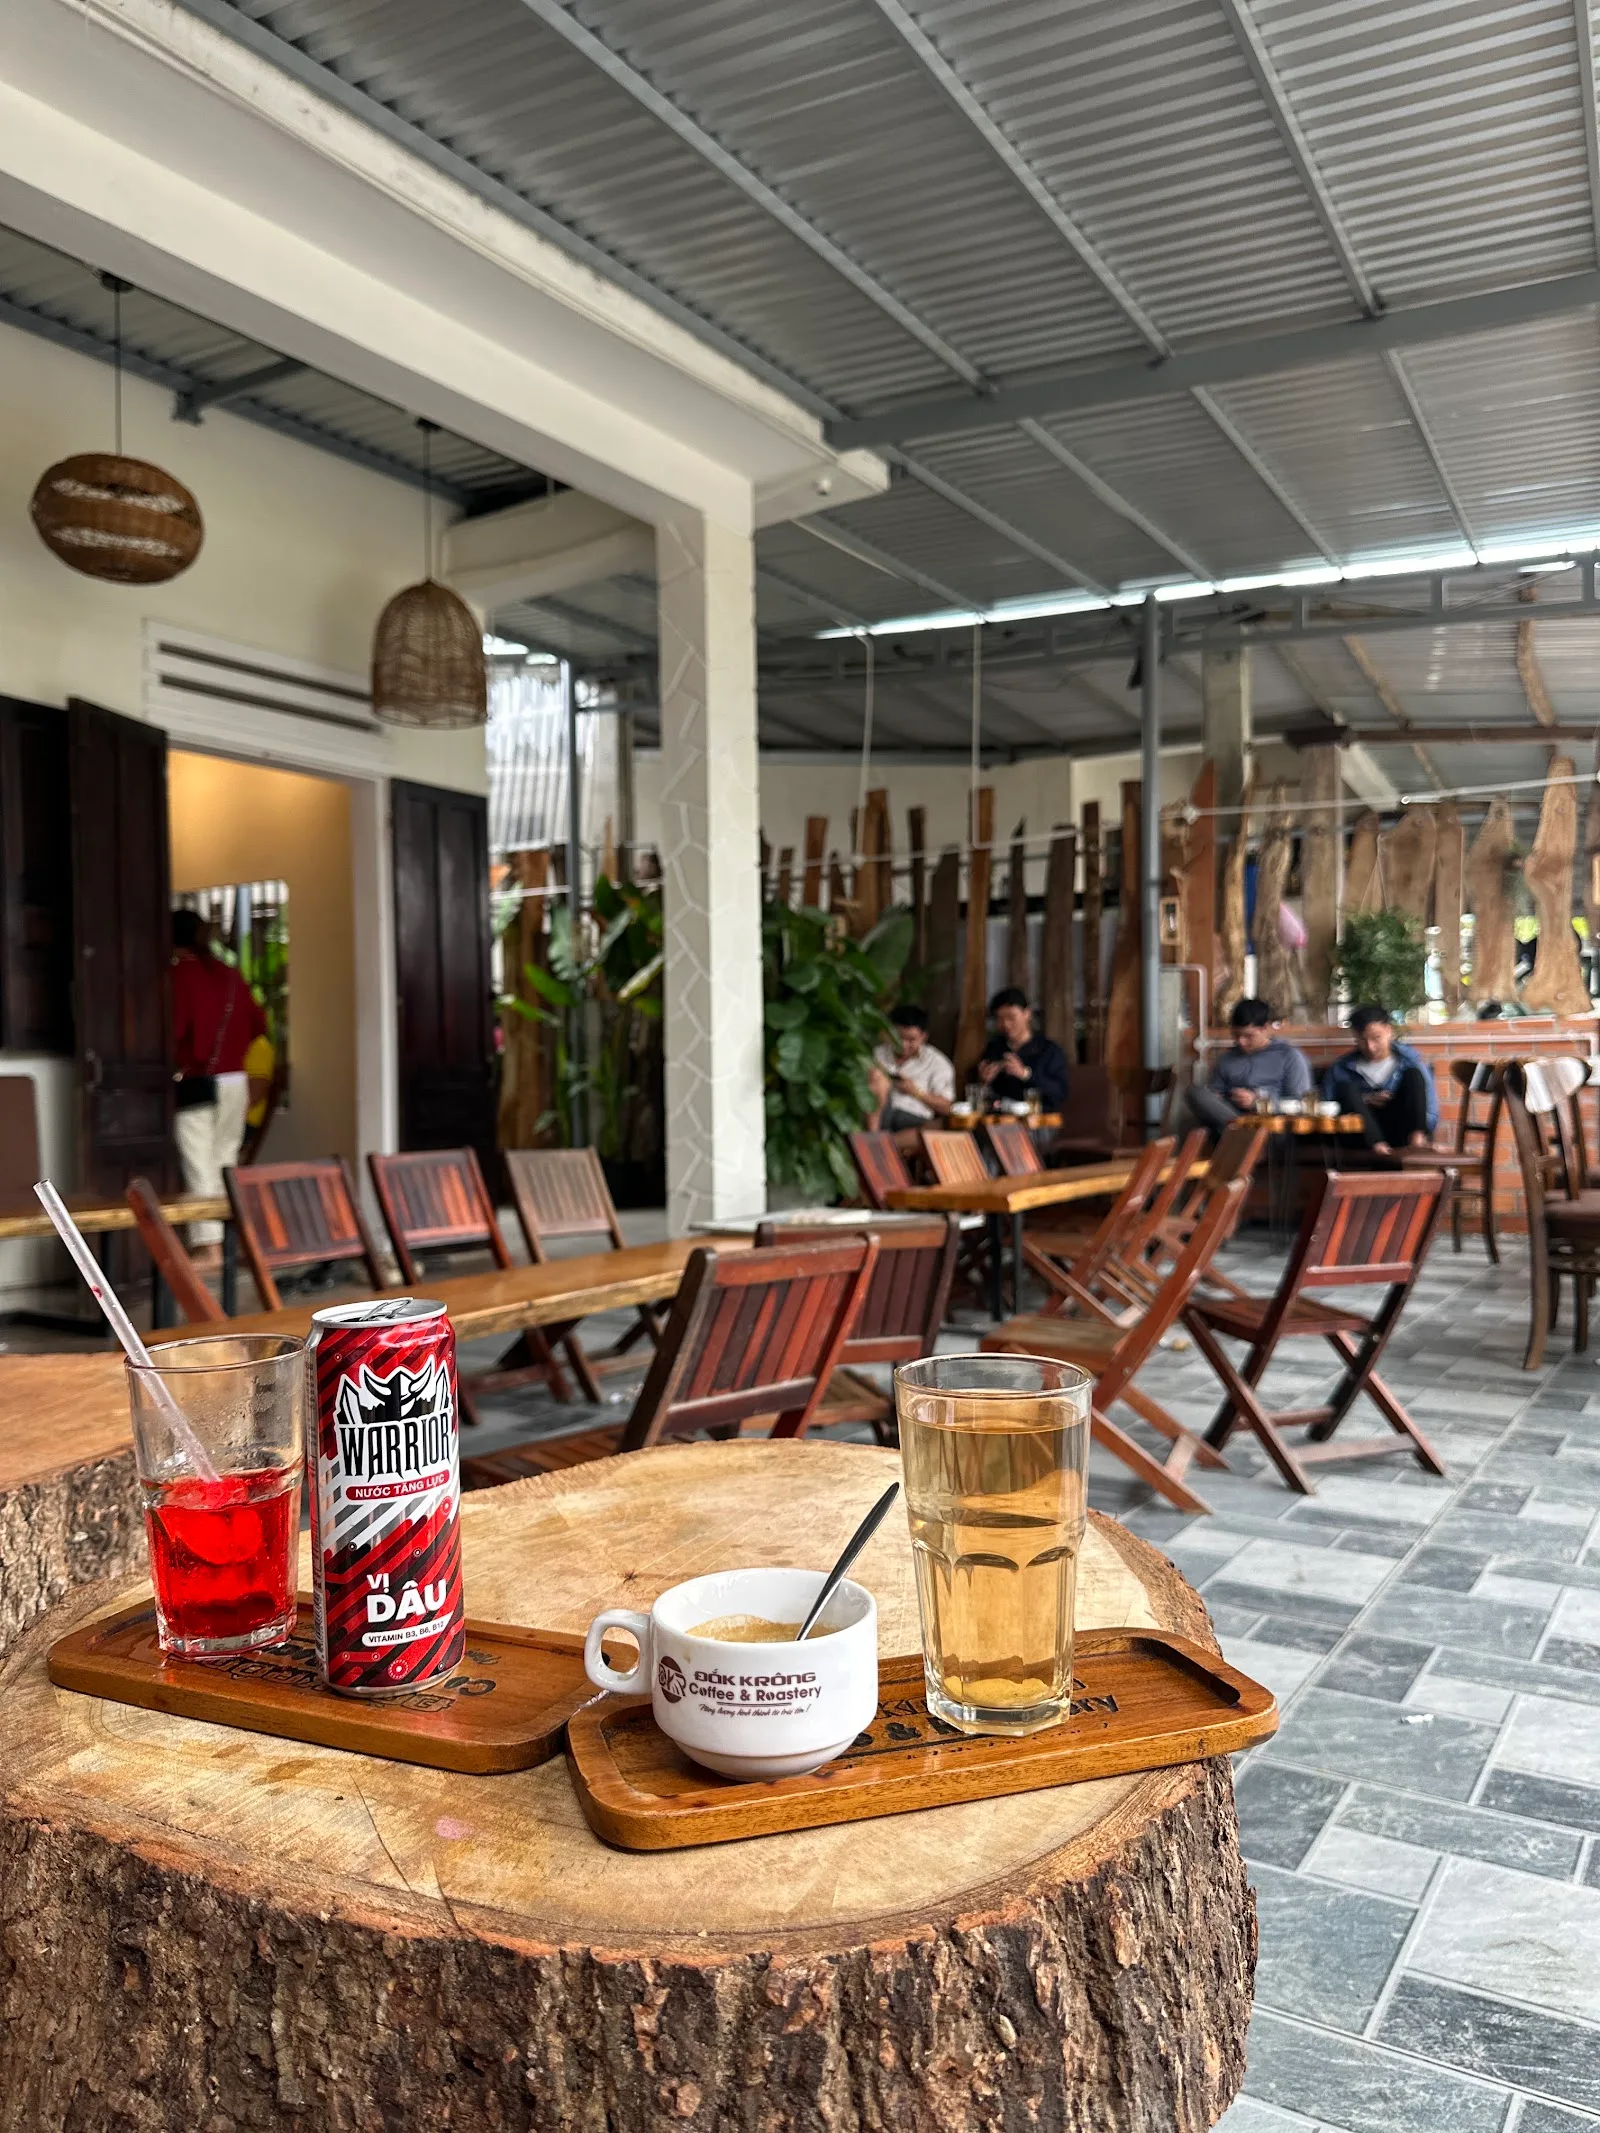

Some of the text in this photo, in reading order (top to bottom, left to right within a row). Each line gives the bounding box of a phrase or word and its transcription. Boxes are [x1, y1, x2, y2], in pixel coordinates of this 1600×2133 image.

[339, 1411, 451, 1482] WARRIOR
[355, 1473, 445, 1498] NƯỚC TĂNG LỰC
[366, 1572, 390, 1594] VỊ
[366, 1578, 447, 1624] DÂU
[368, 1632, 403, 1643] VITAMIN
[405, 1630, 418, 1640] B3,
[693, 1668, 736, 1686] ĐẮK
[689, 1682, 822, 1702] Coffee & Roastery
